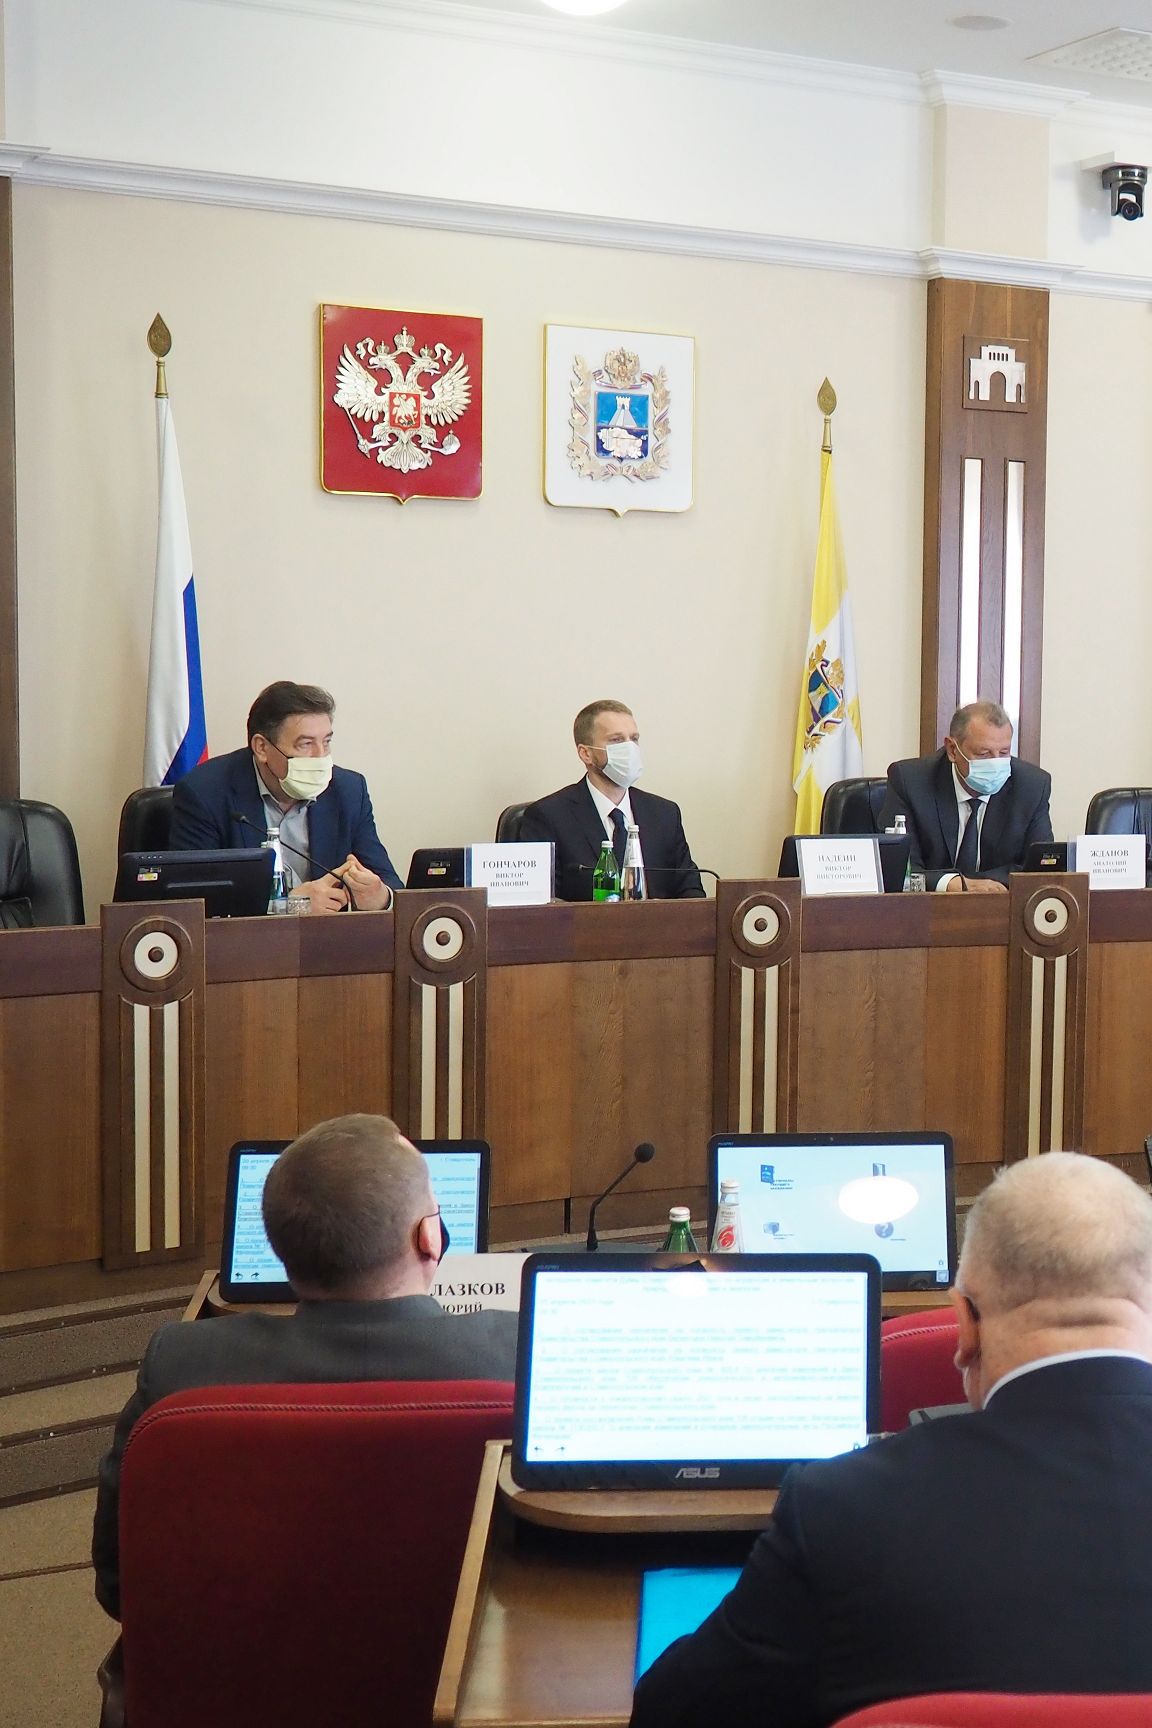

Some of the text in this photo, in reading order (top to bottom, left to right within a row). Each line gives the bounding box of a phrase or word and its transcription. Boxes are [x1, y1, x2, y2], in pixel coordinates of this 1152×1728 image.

[482, 860, 537, 869] ГОНЧАРОВ
[430, 1282, 505, 1296] ЛАЗКОВ
[674, 1467, 721, 1479] ASUS
